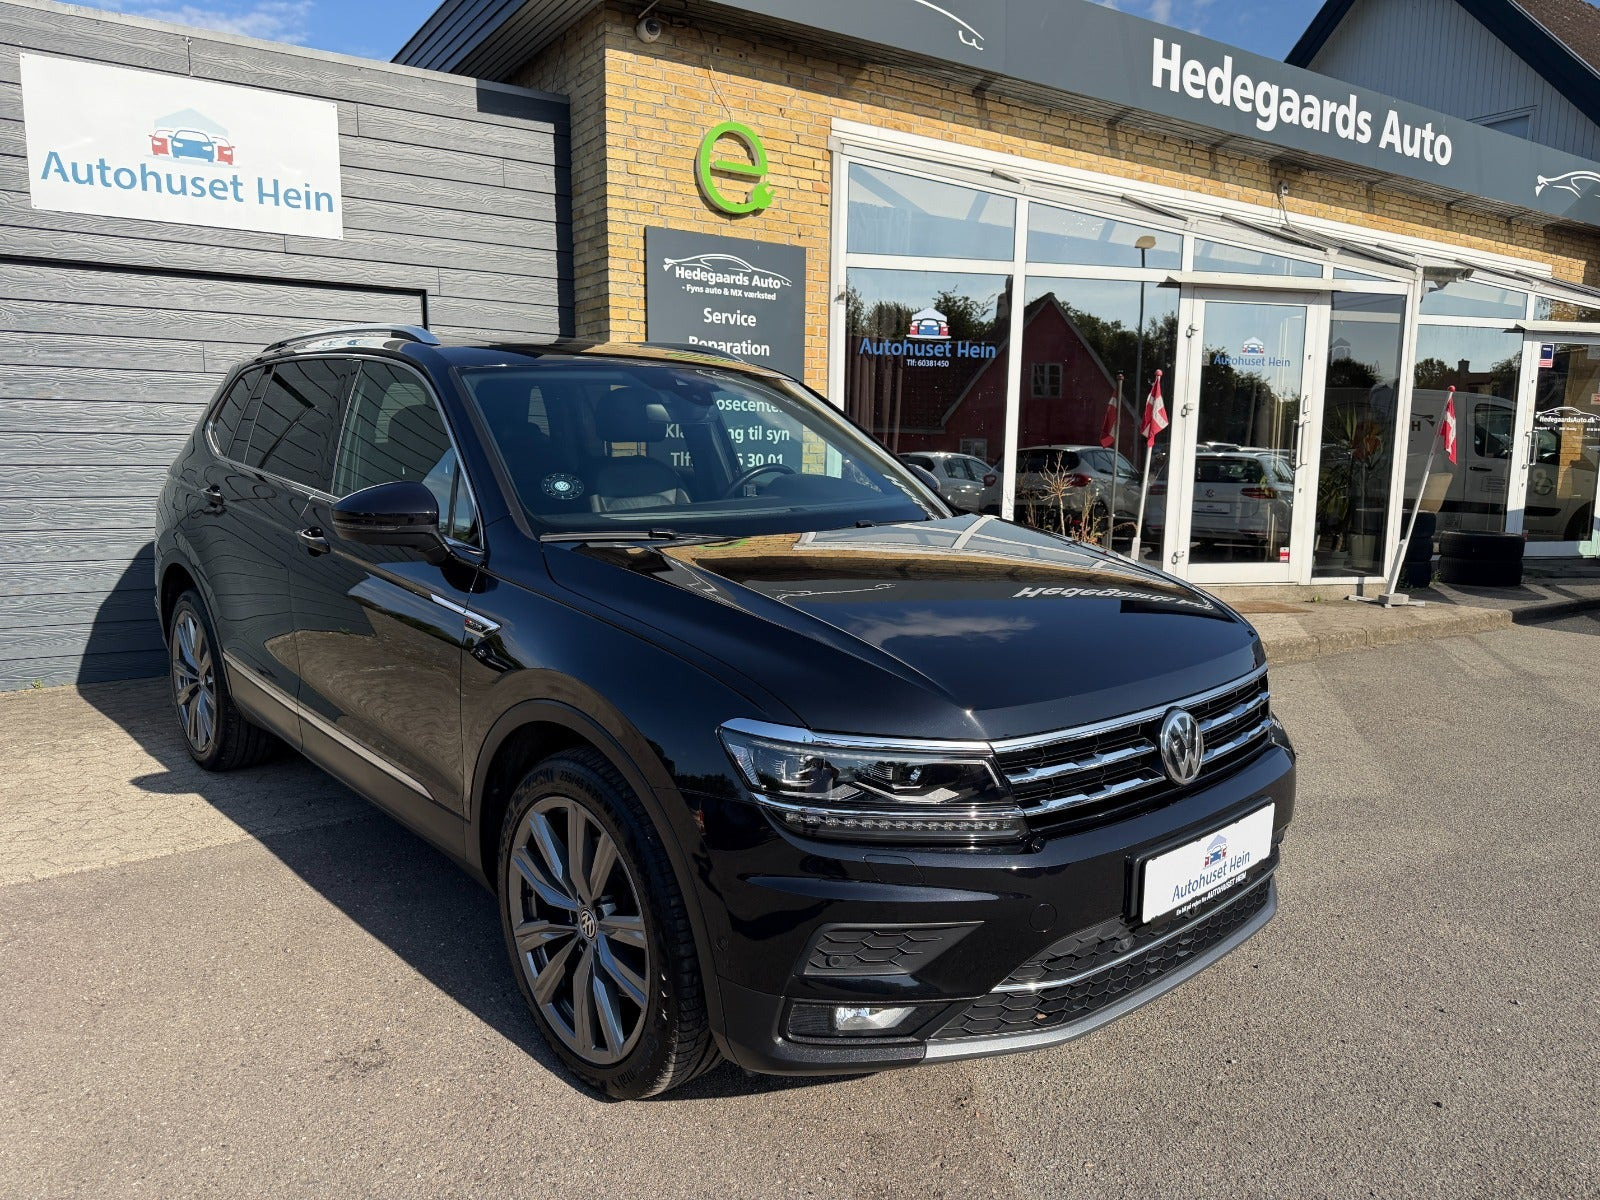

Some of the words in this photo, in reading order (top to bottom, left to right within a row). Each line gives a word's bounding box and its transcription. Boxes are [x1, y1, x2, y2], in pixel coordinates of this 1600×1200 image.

[1151, 36, 1373, 145] Hedegaards
[1378, 108, 1454, 168] Auto
[40, 150, 245, 203] Autohuset
[256, 177, 335, 213] Hein
[675, 265, 749, 286] Hedegaards
[751, 274, 782, 290] Auto
[686, 283, 704, 294] Fyns
[704, 287, 723, 296] auto
[722, 288, 730, 296] &
[730, 288, 743, 298] MX
[743, 290, 777, 301] værksted
[703, 307, 757, 328] Service
[858, 337, 952, 358] Autohuset
[957, 340, 997, 360] Hein
[917, 359, 950, 368] 60381450
[1213, 353, 1266, 367] Autohuset
[1268, 356, 1291, 368] Hein
[747, 425, 763, 441] til
[766, 428, 791, 445] syn
[747, 453, 764, 468] 30
[1170, 861, 1228, 903] Autohuset
[1229, 850, 1250, 873] Hein
